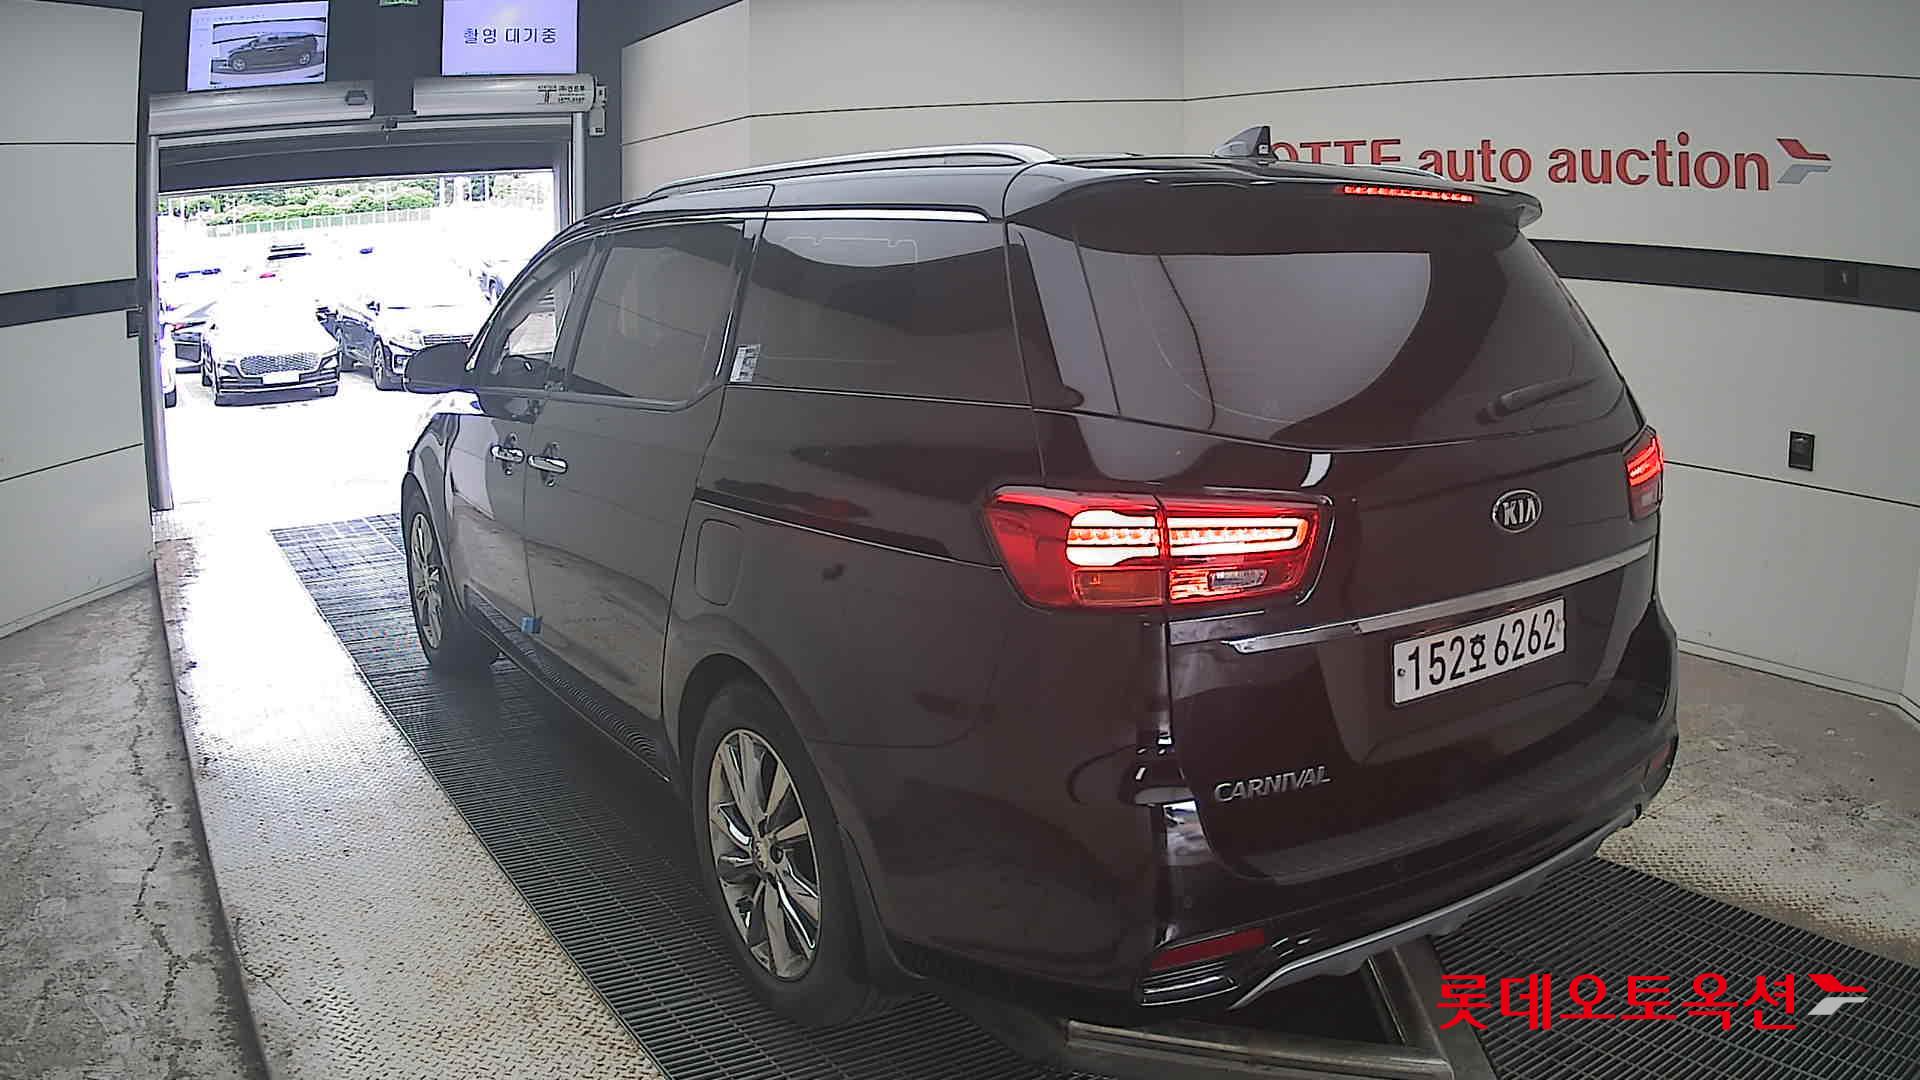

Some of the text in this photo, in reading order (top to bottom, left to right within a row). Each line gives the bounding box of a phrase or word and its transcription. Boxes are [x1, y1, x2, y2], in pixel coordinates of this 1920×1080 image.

[505, 27, 557, 45] 대기중
[1271, 131, 1769, 191] TTE auto auction
[1502, 497, 1537, 526] KIA
[1213, 765, 1332, 802] CARNIVAL
